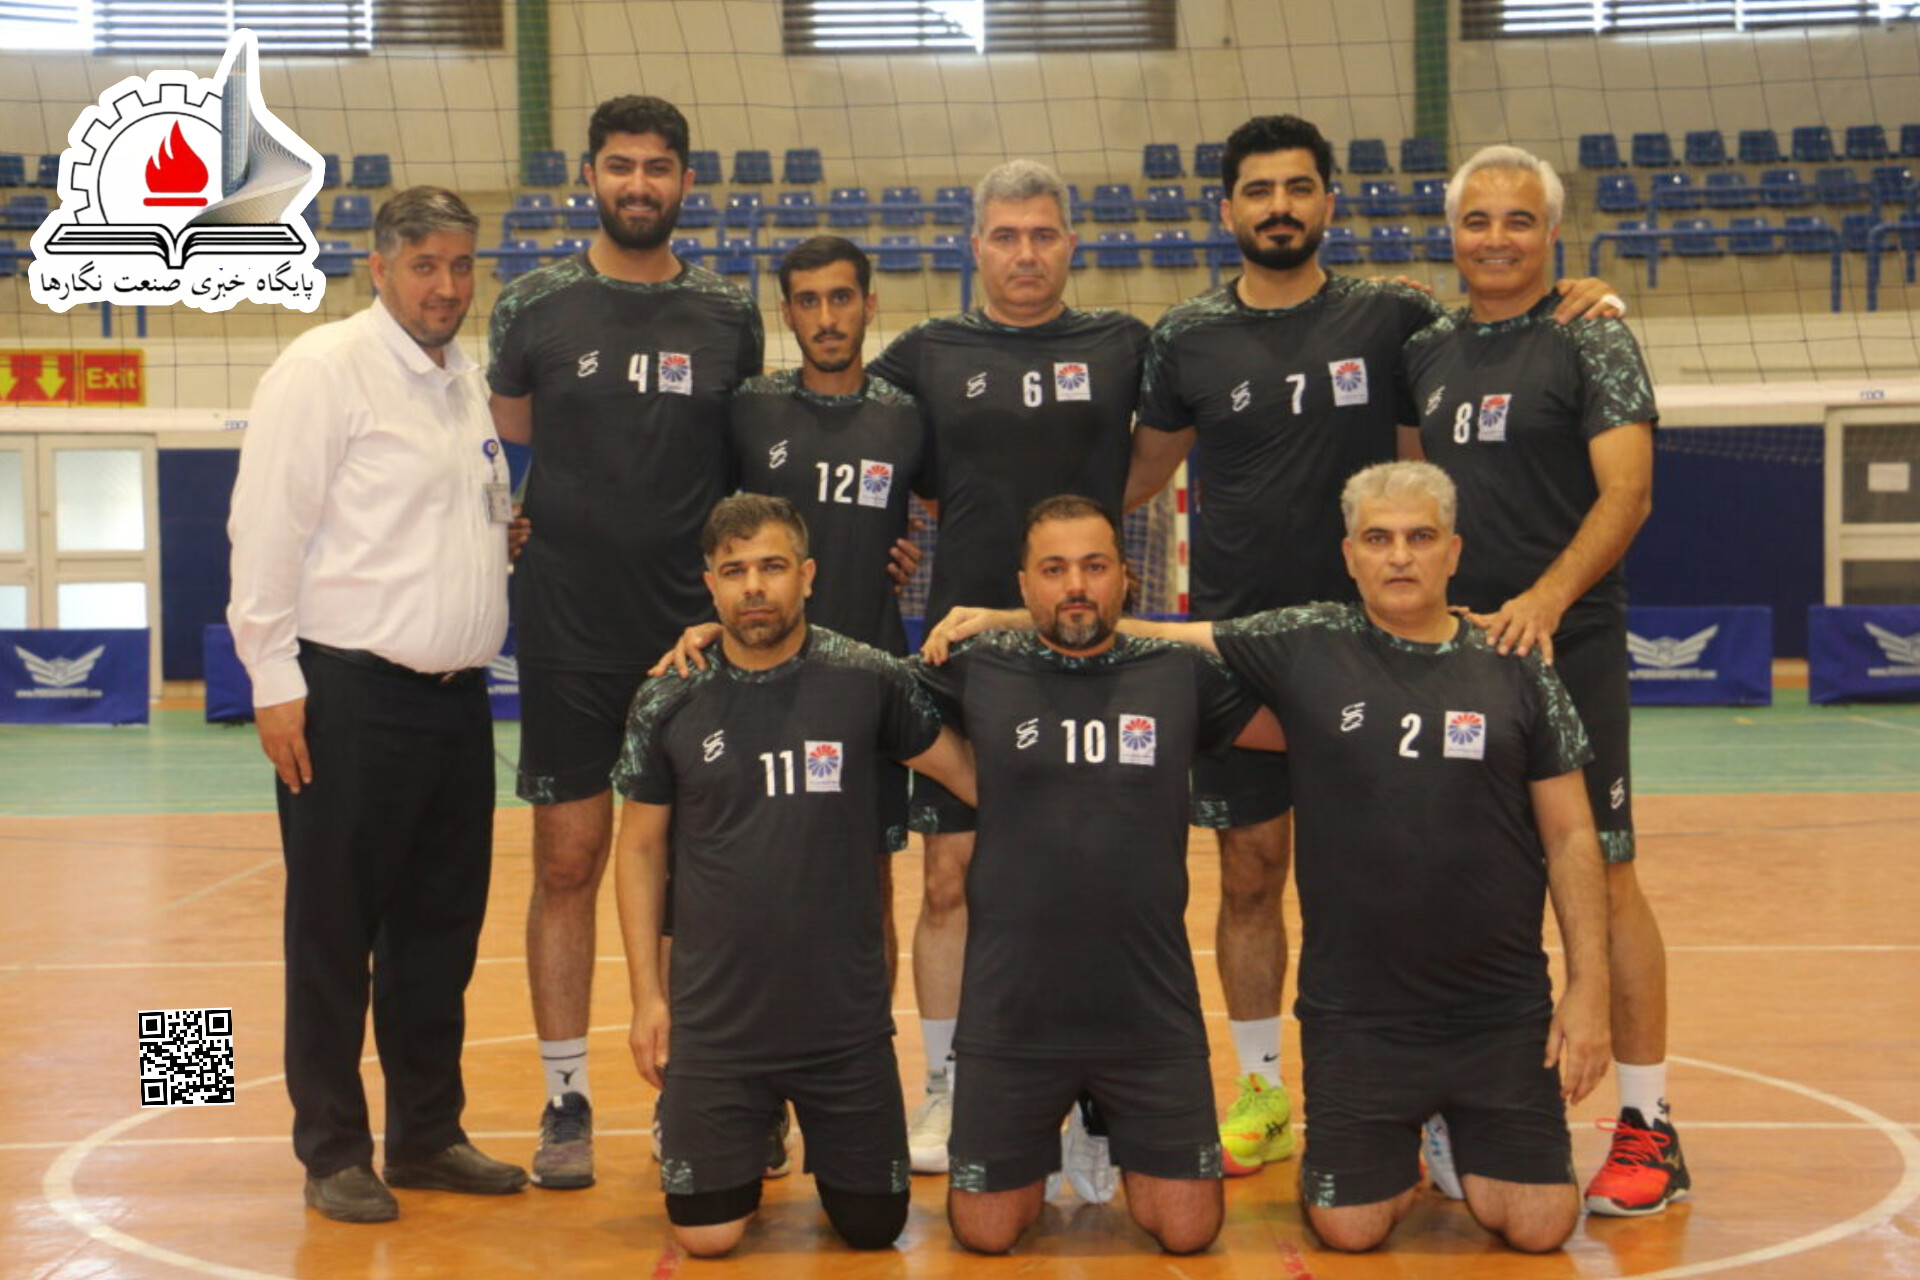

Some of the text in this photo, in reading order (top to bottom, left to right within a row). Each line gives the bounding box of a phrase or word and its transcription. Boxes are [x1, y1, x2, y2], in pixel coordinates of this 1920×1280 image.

[86, 366, 137, 390] Exit
[627, 353, 649, 394] 4
[1022, 370, 1043, 408] 6
[1285, 373, 1306, 415] 7
[1453, 402, 1473, 444] 8
[815, 461, 855, 504] 12
[1060, 719, 1107, 764] 10
[1398, 712, 1422, 759] 2
[759, 749, 795, 798] 11
